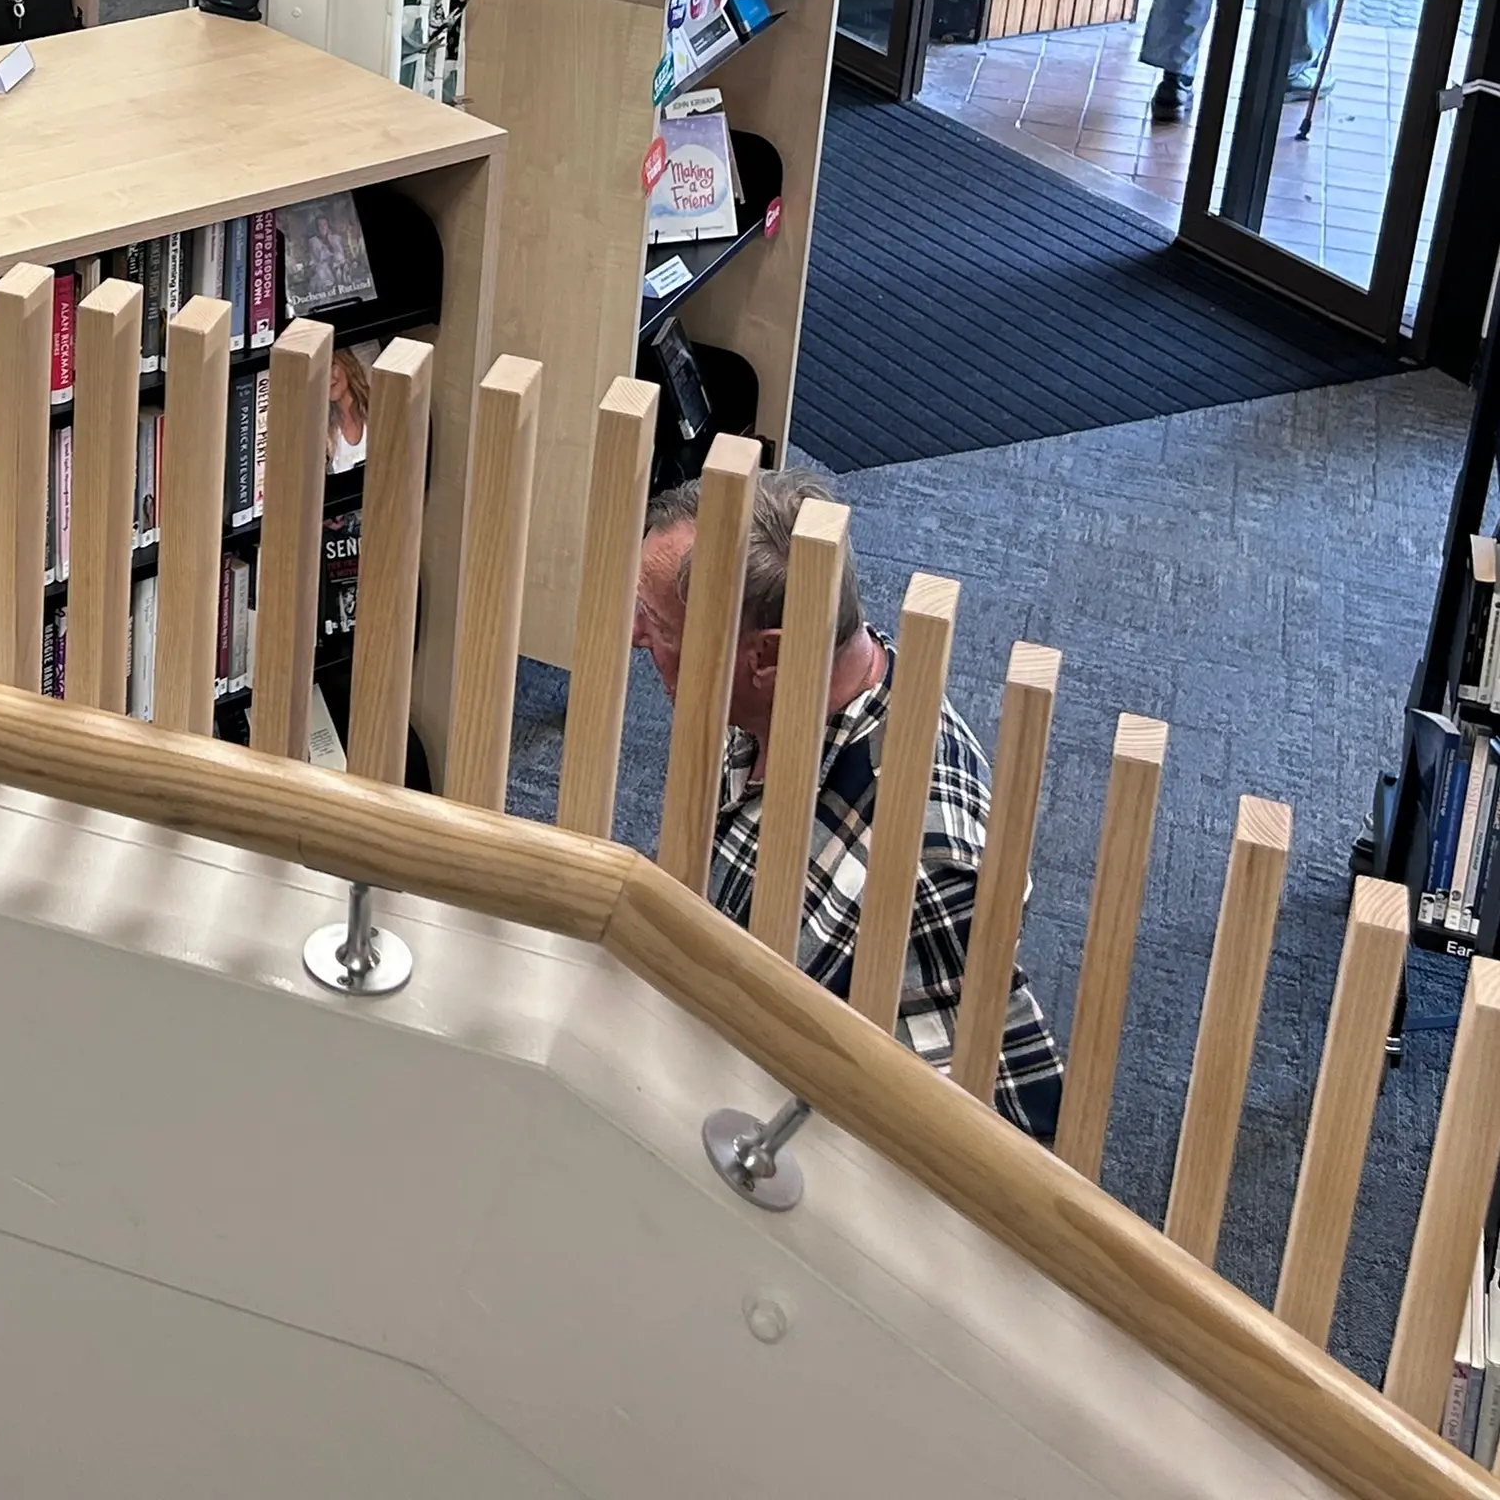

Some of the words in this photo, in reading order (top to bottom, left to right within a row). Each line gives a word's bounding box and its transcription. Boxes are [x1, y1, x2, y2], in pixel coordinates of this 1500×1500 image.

[673, 101, 689, 111] JOHN
[671, 160, 714, 190] Making
[689, 181, 698, 193] a
[671, 185, 715, 211] Friend
[264, 211, 273, 249] CHARD
[169, 248, 180, 288] Farming
[255, 241, 264, 278] GOD'S
[264, 250, 273, 298] SEDDON
[169, 289, 178, 308] Life
[254, 279, 262, 305] OWN
[292, 292, 327, 306] Duchess
[328, 285, 337, 296] of
[337, 277, 372, 295] Rutland
[60, 302, 70, 332] ALAN
[60, 333, 70, 385] RICKMAN
[258, 378, 269, 413] QUEEN
[239, 406, 249, 451] PATRICK
[239, 455, 249, 504] STEWART
[44, 623, 54, 664] MAGGIE
[1446, 940, 1475, 958] Ear
